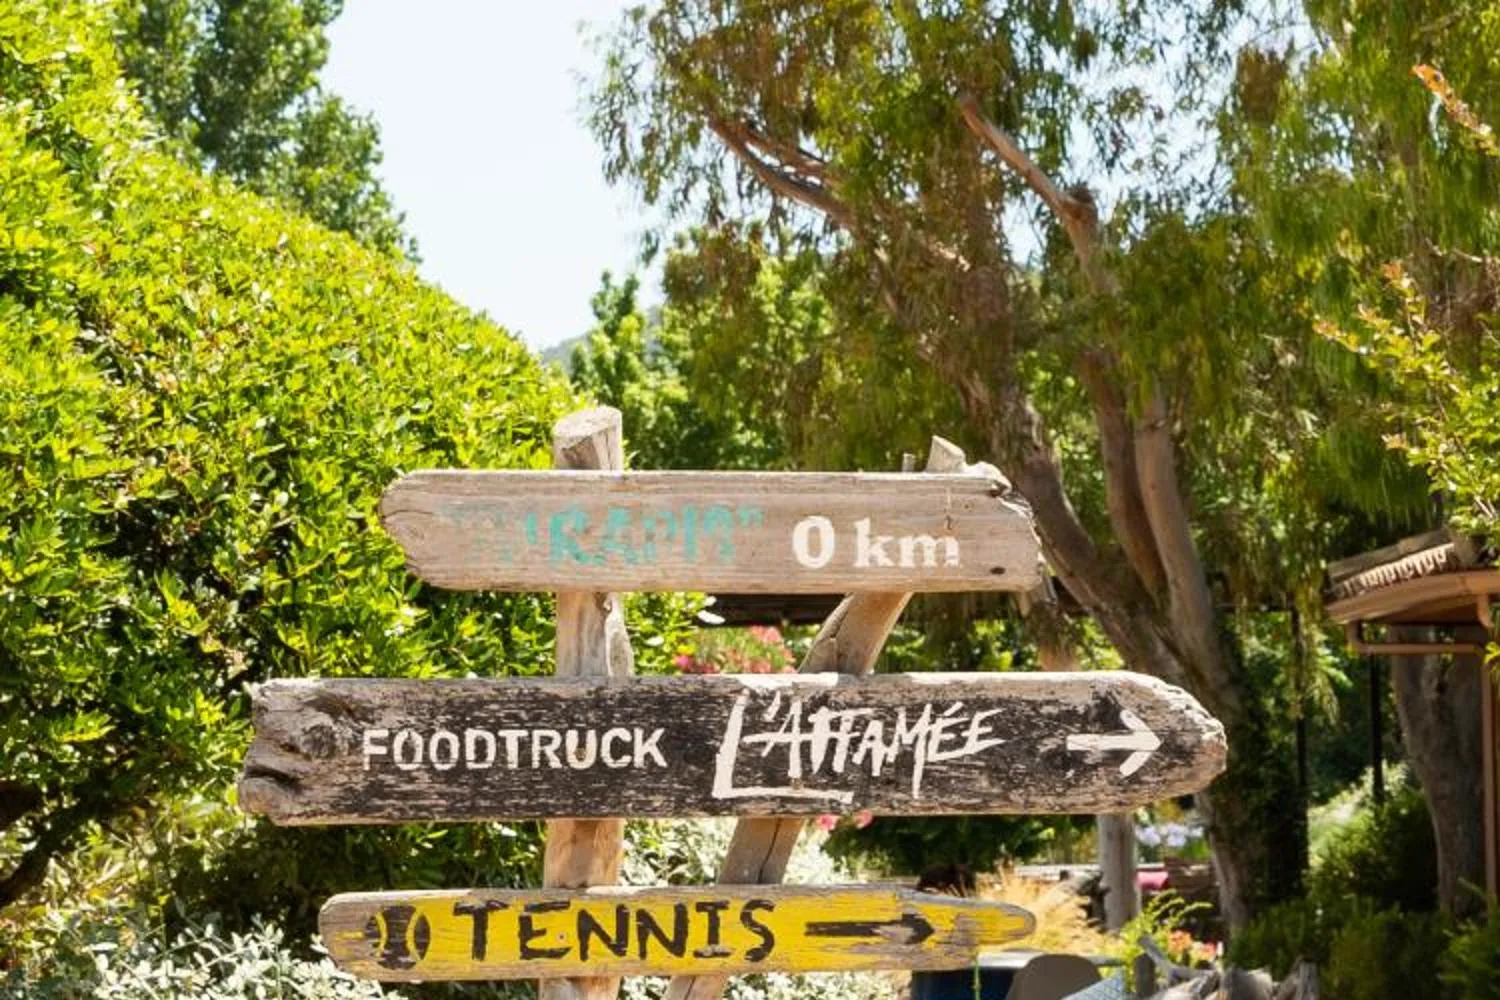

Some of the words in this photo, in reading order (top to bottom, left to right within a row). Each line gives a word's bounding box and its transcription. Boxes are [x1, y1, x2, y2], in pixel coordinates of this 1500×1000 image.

[792, 515, 836, 569] 0
[853, 517, 962, 568] km
[362, 727, 668, 771] FOODTRUCK
[453, 899, 776, 962] TENNIS
